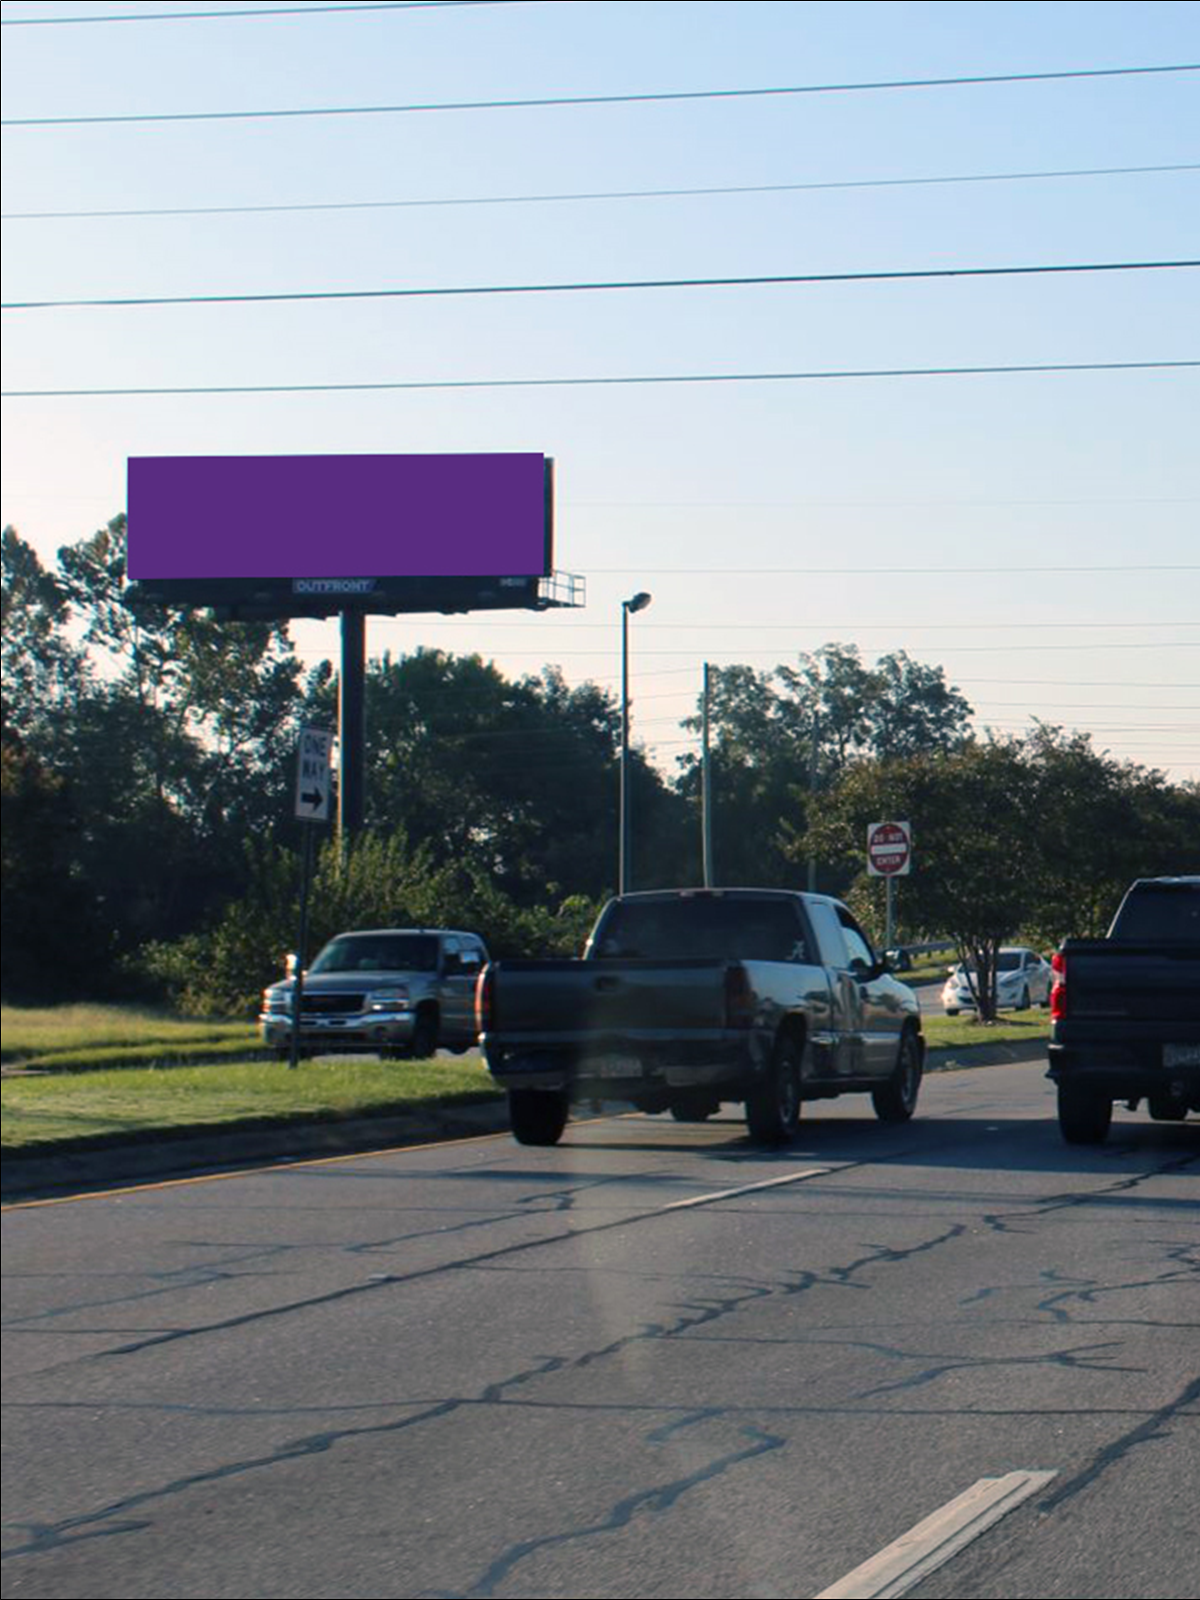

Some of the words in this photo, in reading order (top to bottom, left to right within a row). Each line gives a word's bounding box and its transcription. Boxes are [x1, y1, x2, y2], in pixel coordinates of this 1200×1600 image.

[298, 580, 369, 592] OUTFRONT
[304, 734, 326, 757] ONE
[302, 760, 325, 781] WAY
